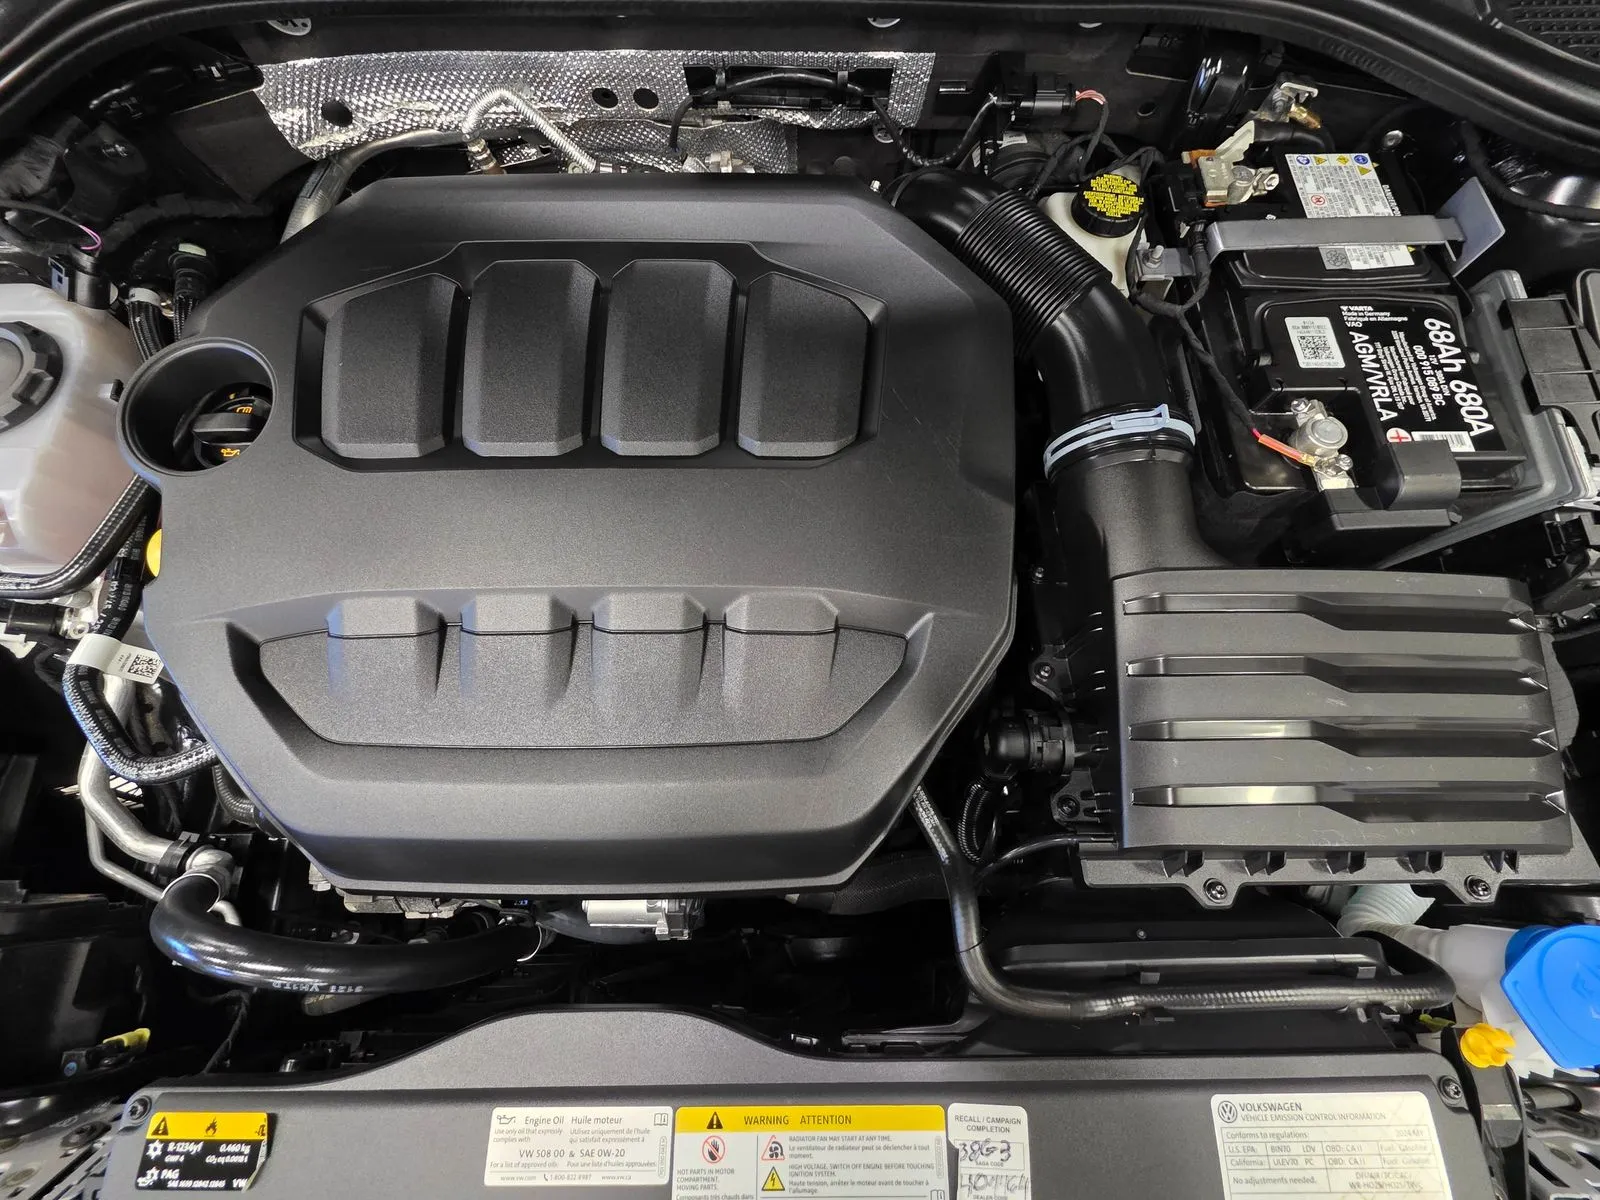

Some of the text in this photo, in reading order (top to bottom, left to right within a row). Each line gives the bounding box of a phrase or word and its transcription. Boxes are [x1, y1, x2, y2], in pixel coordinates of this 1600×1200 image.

[1349, 331, 1398, 421] AGM/VRLA
[1413, 345, 1445, 405] 000 915 089 BC
[1424, 318, 1494, 437] 68Ah 680A
[1428, 354, 1438, 364] 12V
[1440, 384, 1450, 395] DIN
[1239, 1103, 1302, 1111] VOLKSWAGEN
[525, 1116, 622, 1127] Engine Oil Huile moteur
[744, 1114, 852, 1125] WARNING ATTENTION
[954, 1115, 981, 1123] RECALL
[986, 1117, 1021, 1125] CAMPAIGN
[1241, 1114, 1268, 1122] VEHICLE
[505, 1128, 516, 1136] only
[591, 1128, 624, 1136] uniquement
[967, 1125, 1010, 1133] COMPLETION
[1226, 1131, 1259, 1139] Conforms
[241, 1144, 251, 1154] kg
[520, 1150, 534, 1158] VW
[536, 1149, 551, 1158] 508
[554, 1149, 564, 1157] 00
[580, 1149, 595, 1157] SAE
[597, 1149, 625, 1157] 0W-20
[160, 1169, 180, 1179] PAG
[1245, 1177, 1288, 1186] adjustments
[1289, 1176, 1316, 1184] needed.
